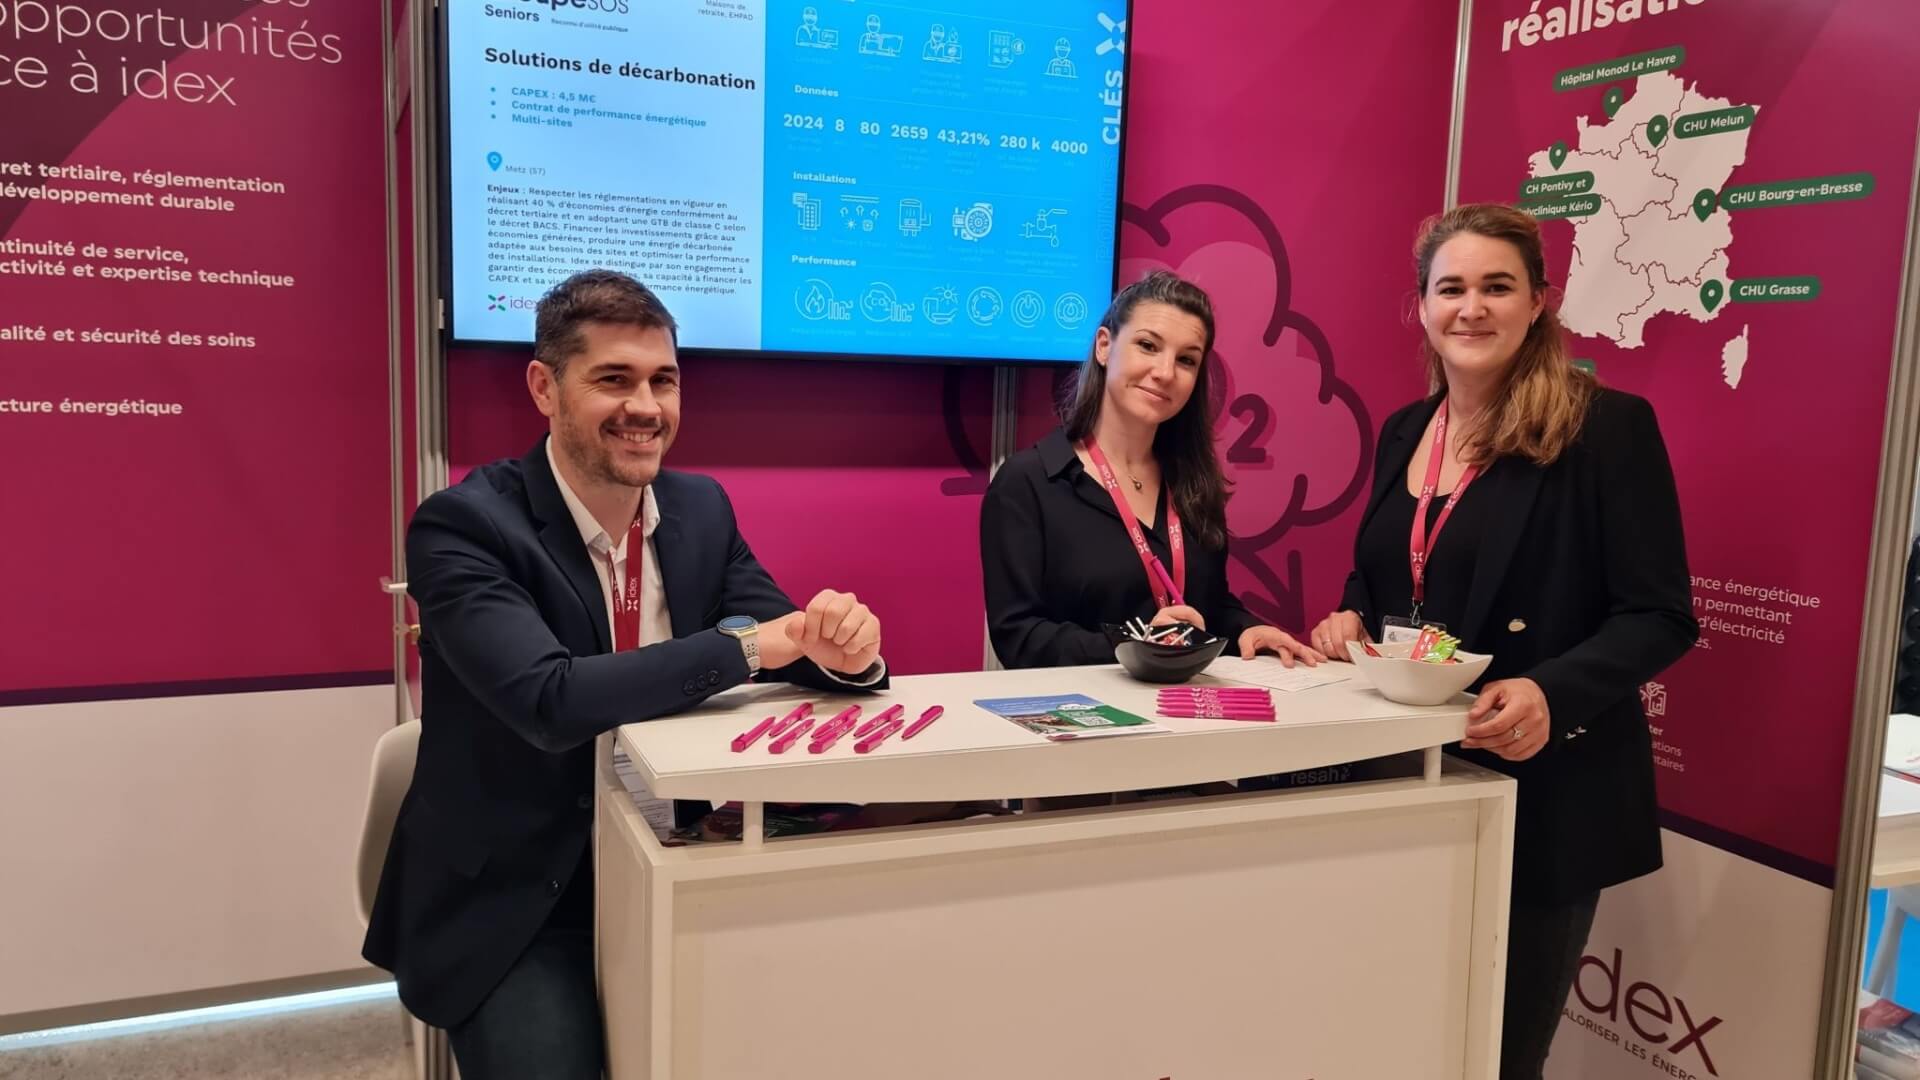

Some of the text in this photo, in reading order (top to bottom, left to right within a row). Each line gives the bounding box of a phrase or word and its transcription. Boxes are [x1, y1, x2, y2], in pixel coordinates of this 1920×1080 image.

[485, 4, 540, 22] Seniors
[0, 0, 342, 64] pportunités
[70, 48, 98, 93] à
[120, 56, 237, 106] idex
[485, 47, 756, 91] Solutions de décarbonation
[1560, 53, 1677, 87] Hôpital Monod Le Havre
[511, 87, 548, 99] CAPEX
[559, 91, 576, 102] 4,5
[794, 84, 839, 97] Données
[511, 100, 707, 128] Contrat de performance énergétique
[1099, 68, 1124, 145] CLÉS
[511, 113, 573, 128] Multi-sites
[1683, 113, 1745, 133] CHU Melun
[783, 113, 1088, 155] 2024 8 80 2659 43,21% 280 k 4000
[38, 163, 127, 185] tertiaire,
[133, 168, 286, 194] réglementation
[792, 170, 857, 185] Installations
[1526, 179, 1586, 194] CH Pontivy et
[160, 193, 235, 212] durable
[487, 184, 519, 195] Enjeux
[528, 187, 575, 198] Respecter
[578, 191, 592, 200] les
[594, 192, 667, 205] réglementations
[682, 199, 714, 209] vigueur
[1729, 181, 1864, 204] CHU Bourg-en-Bresse
[487, 195, 529, 206] réalisant
[727, 213, 738, 221] au
[487, 207, 519, 217] décret
[521, 209, 558, 219] tertiaire
[587, 214, 629, 225] adoptant
[631, 218, 648, 226] une
[671, 219, 682, 228] de
[684, 221, 712, 230] classe
[488, 230, 538, 240] économies
[499, 219, 531, 229] décret
[563, 223, 603, 233] Financer
[82, 242, 108, 259] de
[113, 245, 189, 264] service,
[488, 251, 505, 260] des
[548, 245, 584, 255] besoins
[587, 246, 603, 256] des
[605, 248, 627, 257] sites
[791, 254, 857, 267] Performance
[0, 259, 295, 288] ctivité et expertise technique
[488, 274, 520, 284] CAPEX
[527, 265, 545, 274] des
[1739, 283, 1811, 297] CHU Grasse
[0, 325, 256, 348] alité et sécurité des soins
[0, 397, 183, 417] cture énergétique
[627, 576, 638, 599] idex
[1725, 578, 1821, 609] énergétique
[1705, 598, 1793, 625] permettant
[1698, 615, 1785, 645] d'électricité
[1562, 1008, 1620, 1046] ALORISER
[1624, 1040, 1647, 1061] LES
